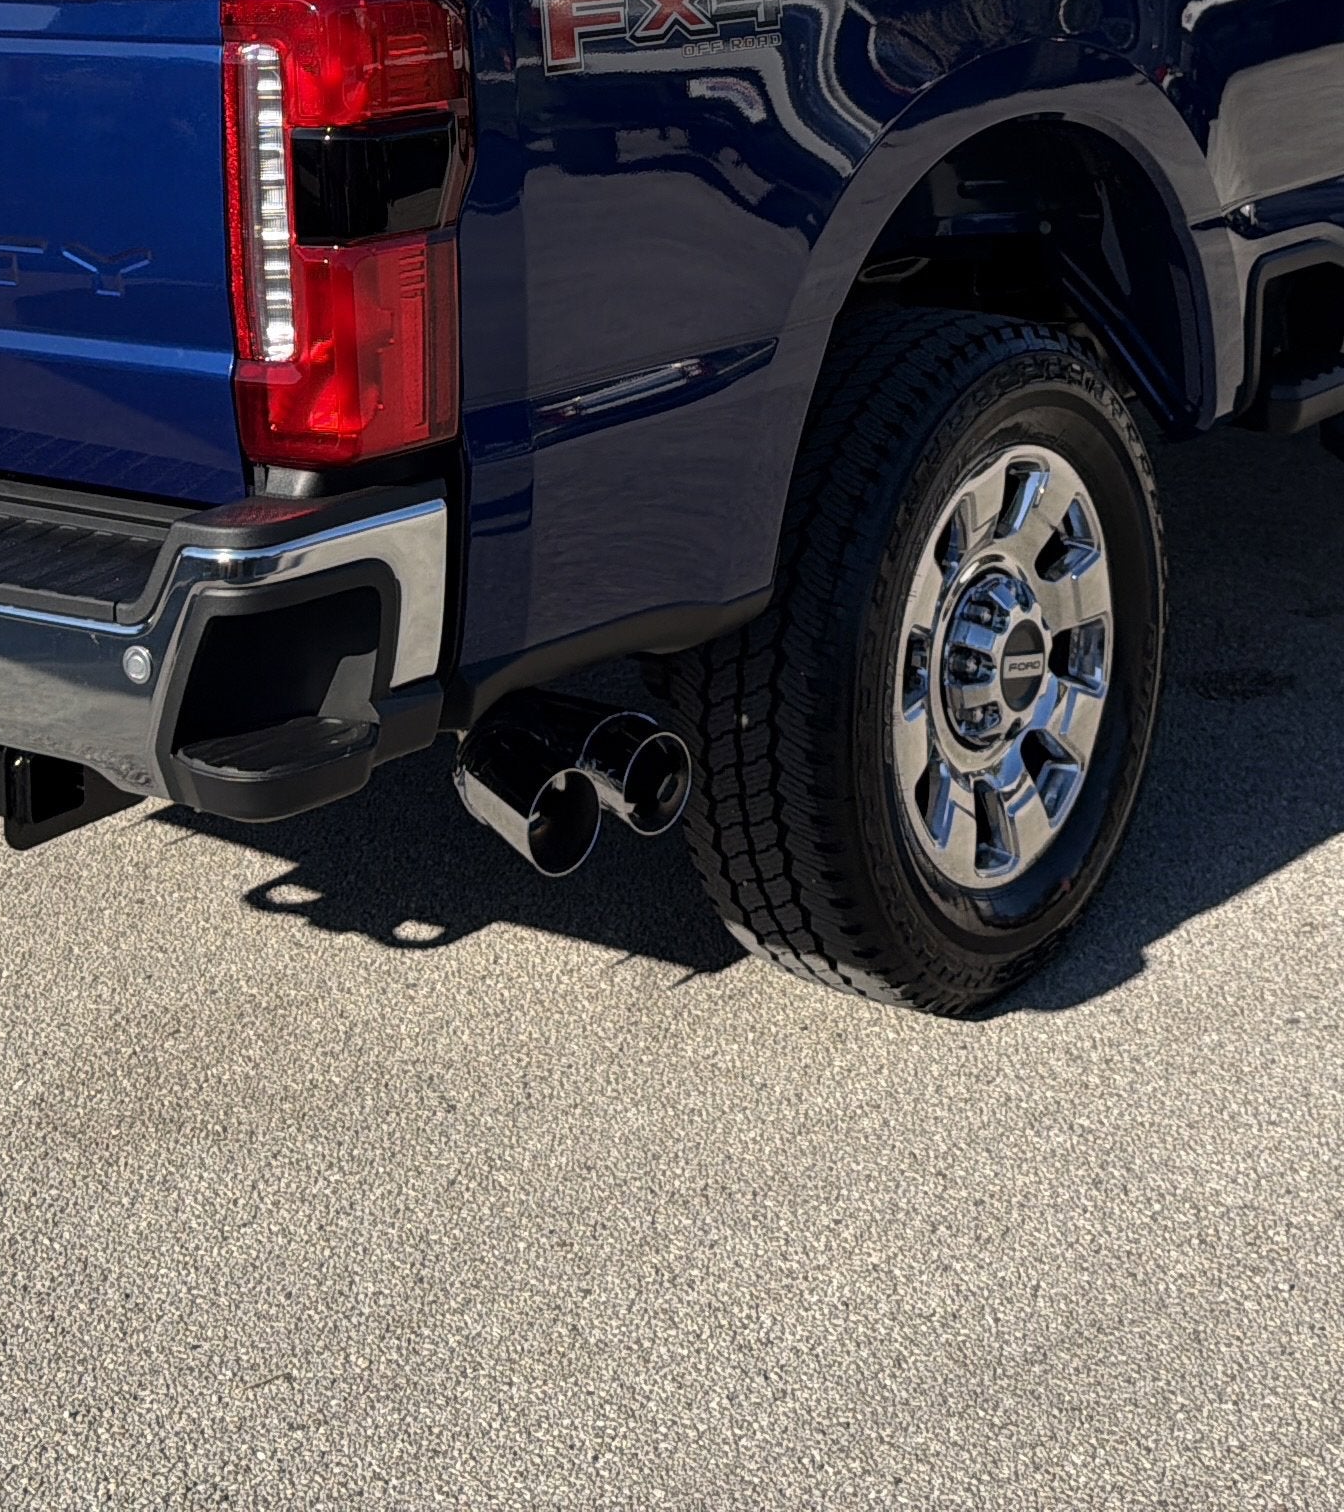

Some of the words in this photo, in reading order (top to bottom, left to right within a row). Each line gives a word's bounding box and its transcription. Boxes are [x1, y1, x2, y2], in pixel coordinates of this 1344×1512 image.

[682, 38, 724, 58] OFF
[730, 32, 783, 52] ROAD
[1009, 660, 1040, 672] FORD
